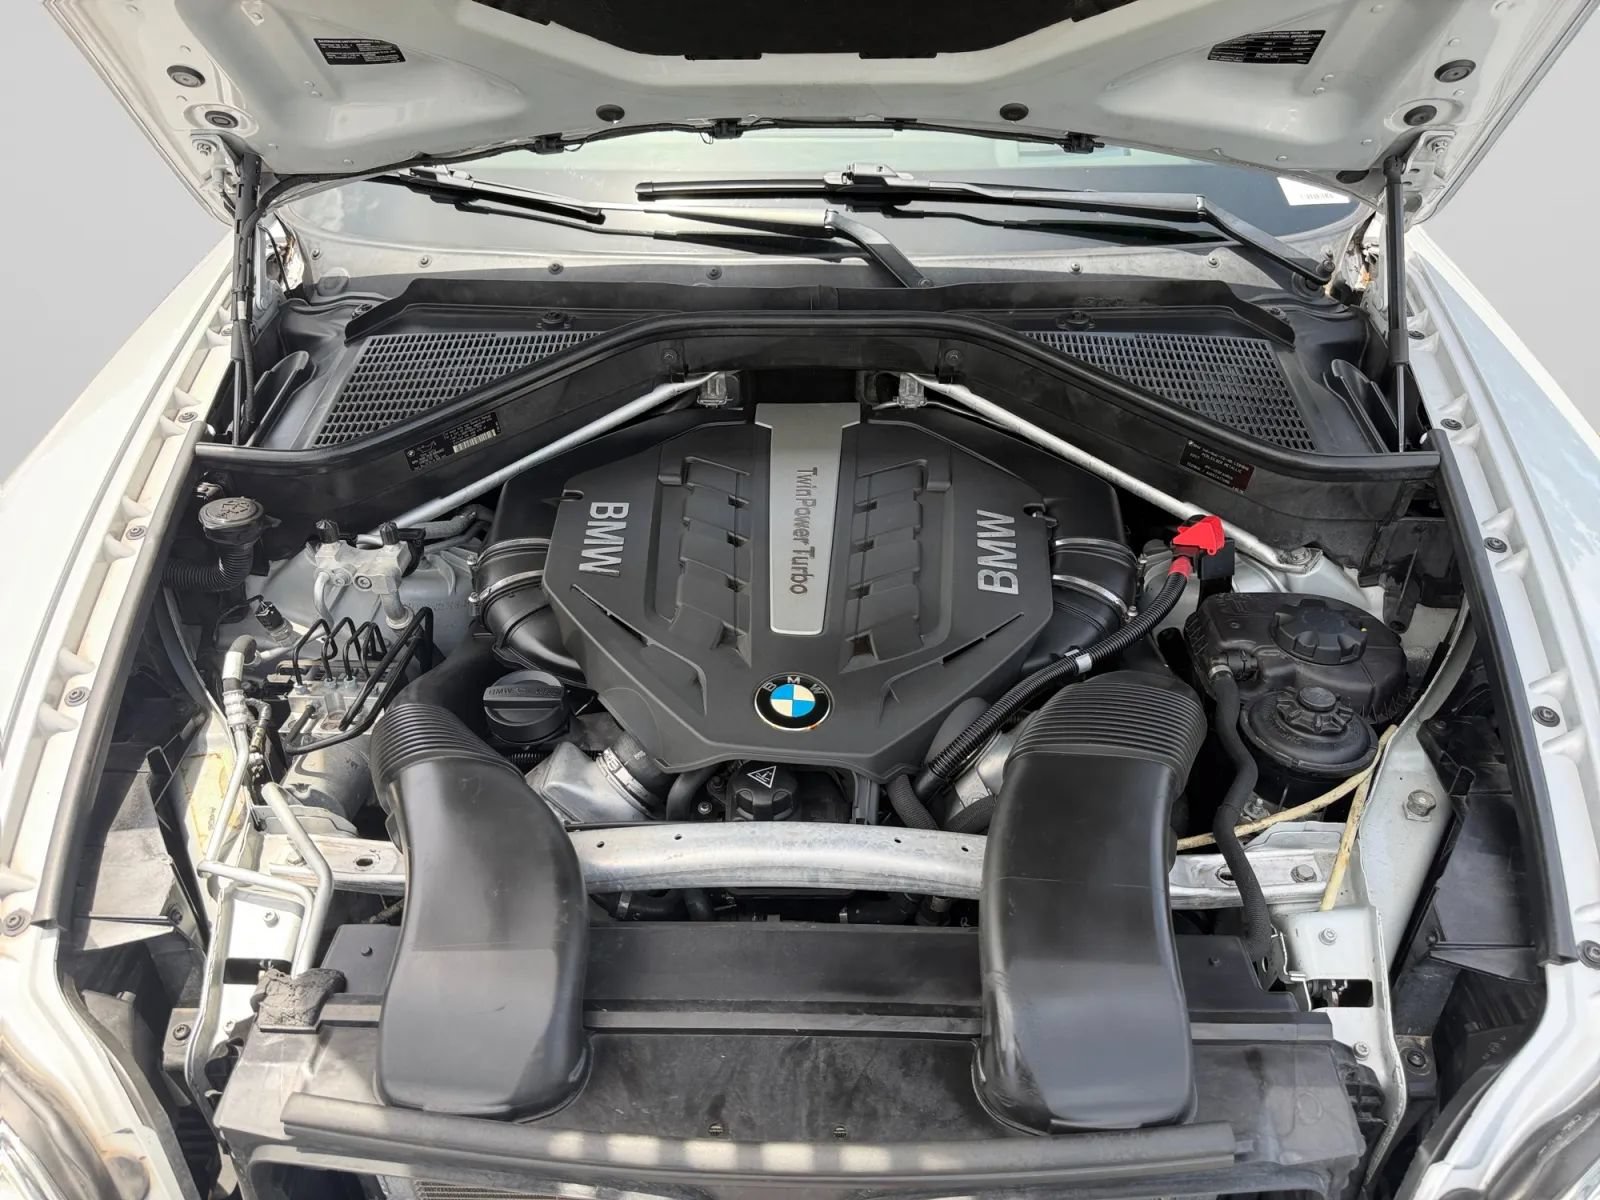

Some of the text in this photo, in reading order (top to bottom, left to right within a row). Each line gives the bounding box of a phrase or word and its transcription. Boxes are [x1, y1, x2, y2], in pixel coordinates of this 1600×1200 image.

[578, 502, 630, 577] BMW
[789, 467, 818, 595] TwinPower Turbo
[976, 509, 1019, 595] BMW
[762, 676, 825, 695] BMW
